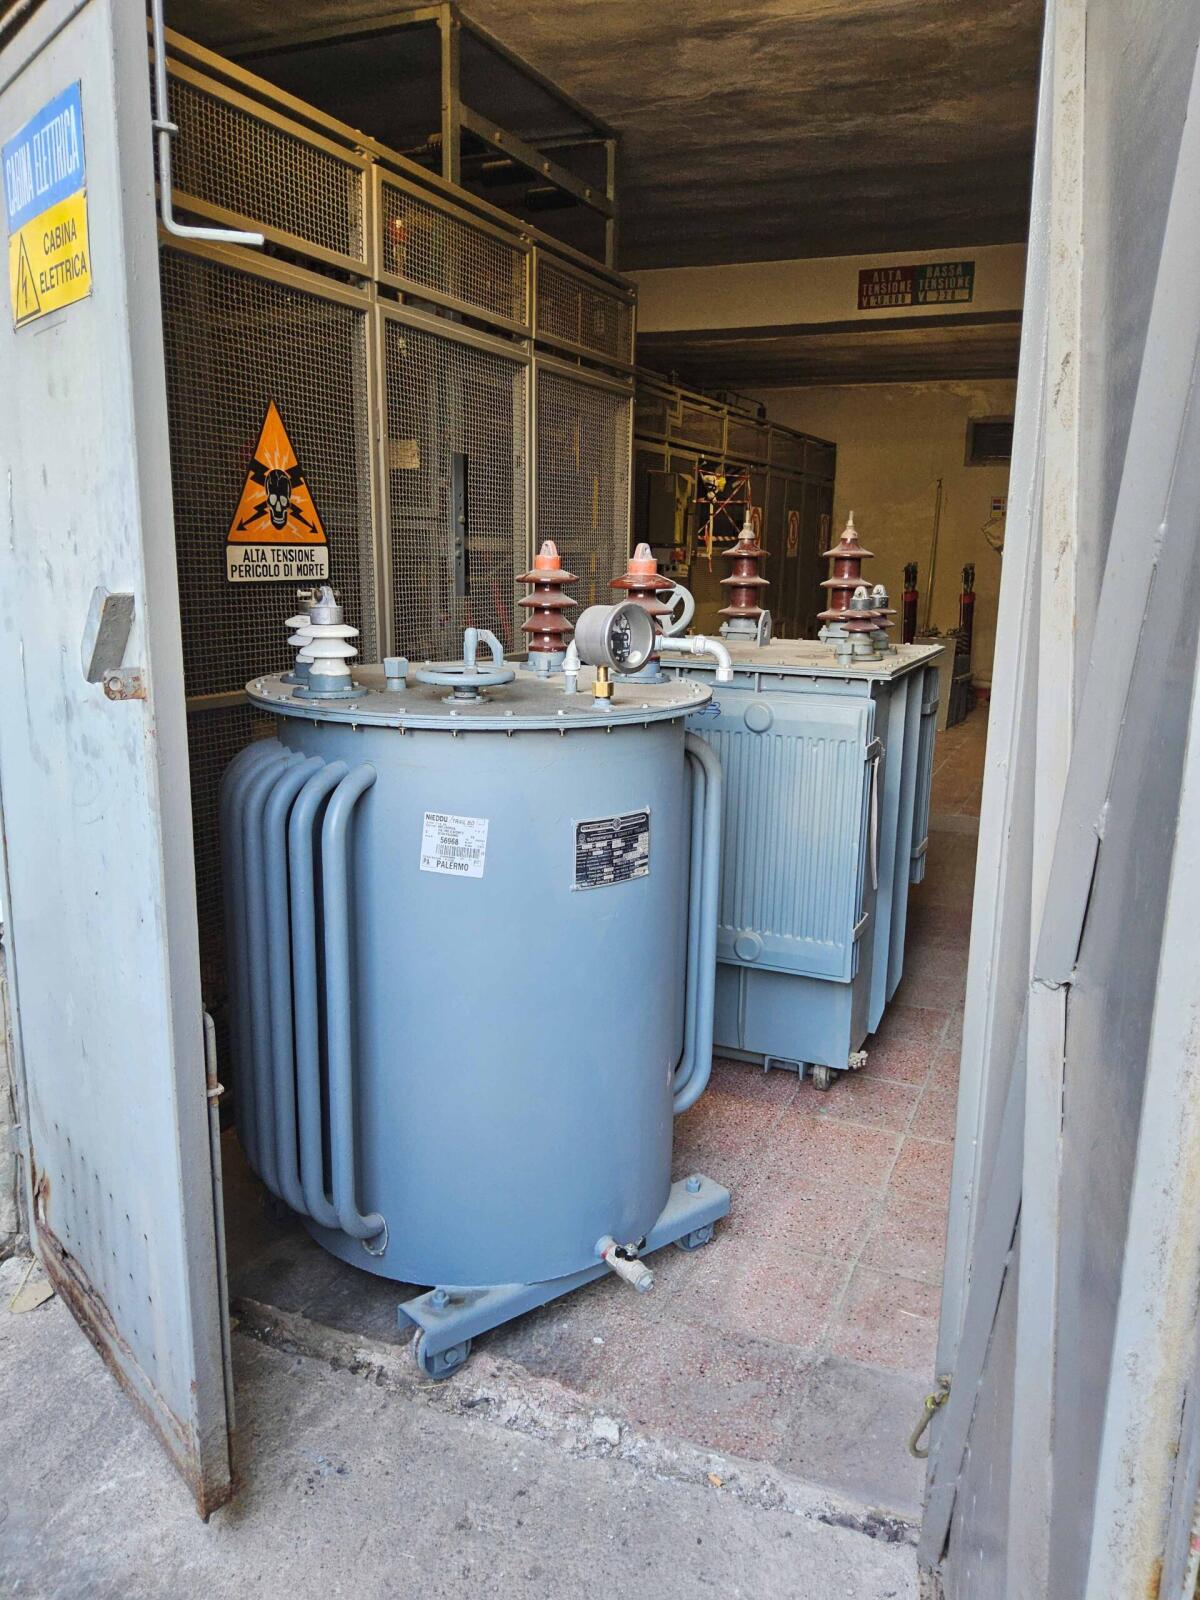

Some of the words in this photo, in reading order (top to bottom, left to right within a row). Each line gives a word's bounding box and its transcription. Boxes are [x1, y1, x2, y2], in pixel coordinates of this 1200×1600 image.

[6, 141, 34, 216] CABINA
[34, 105, 80, 195] ELETTRICA
[43, 217, 78, 255] CABINA
[39, 252, 88, 294] ELETTRICA
[872, 269, 902, 282] ALTA
[926, 265, 963, 278] BASSA
[863, 281, 912, 295] TENSIONE
[919, 276, 970, 290] TENSIONE
[243, 549, 267, 563] ALTA
[271, 549, 315, 563] TENSIONE
[231, 564, 280, 578] PERICOLO
[283, 564, 293, 577] DI
[296, 563, 325, 577] MORTE
[425, 814, 448, 823] NIEDDU
[436, 860, 469, 871] PALERMO
